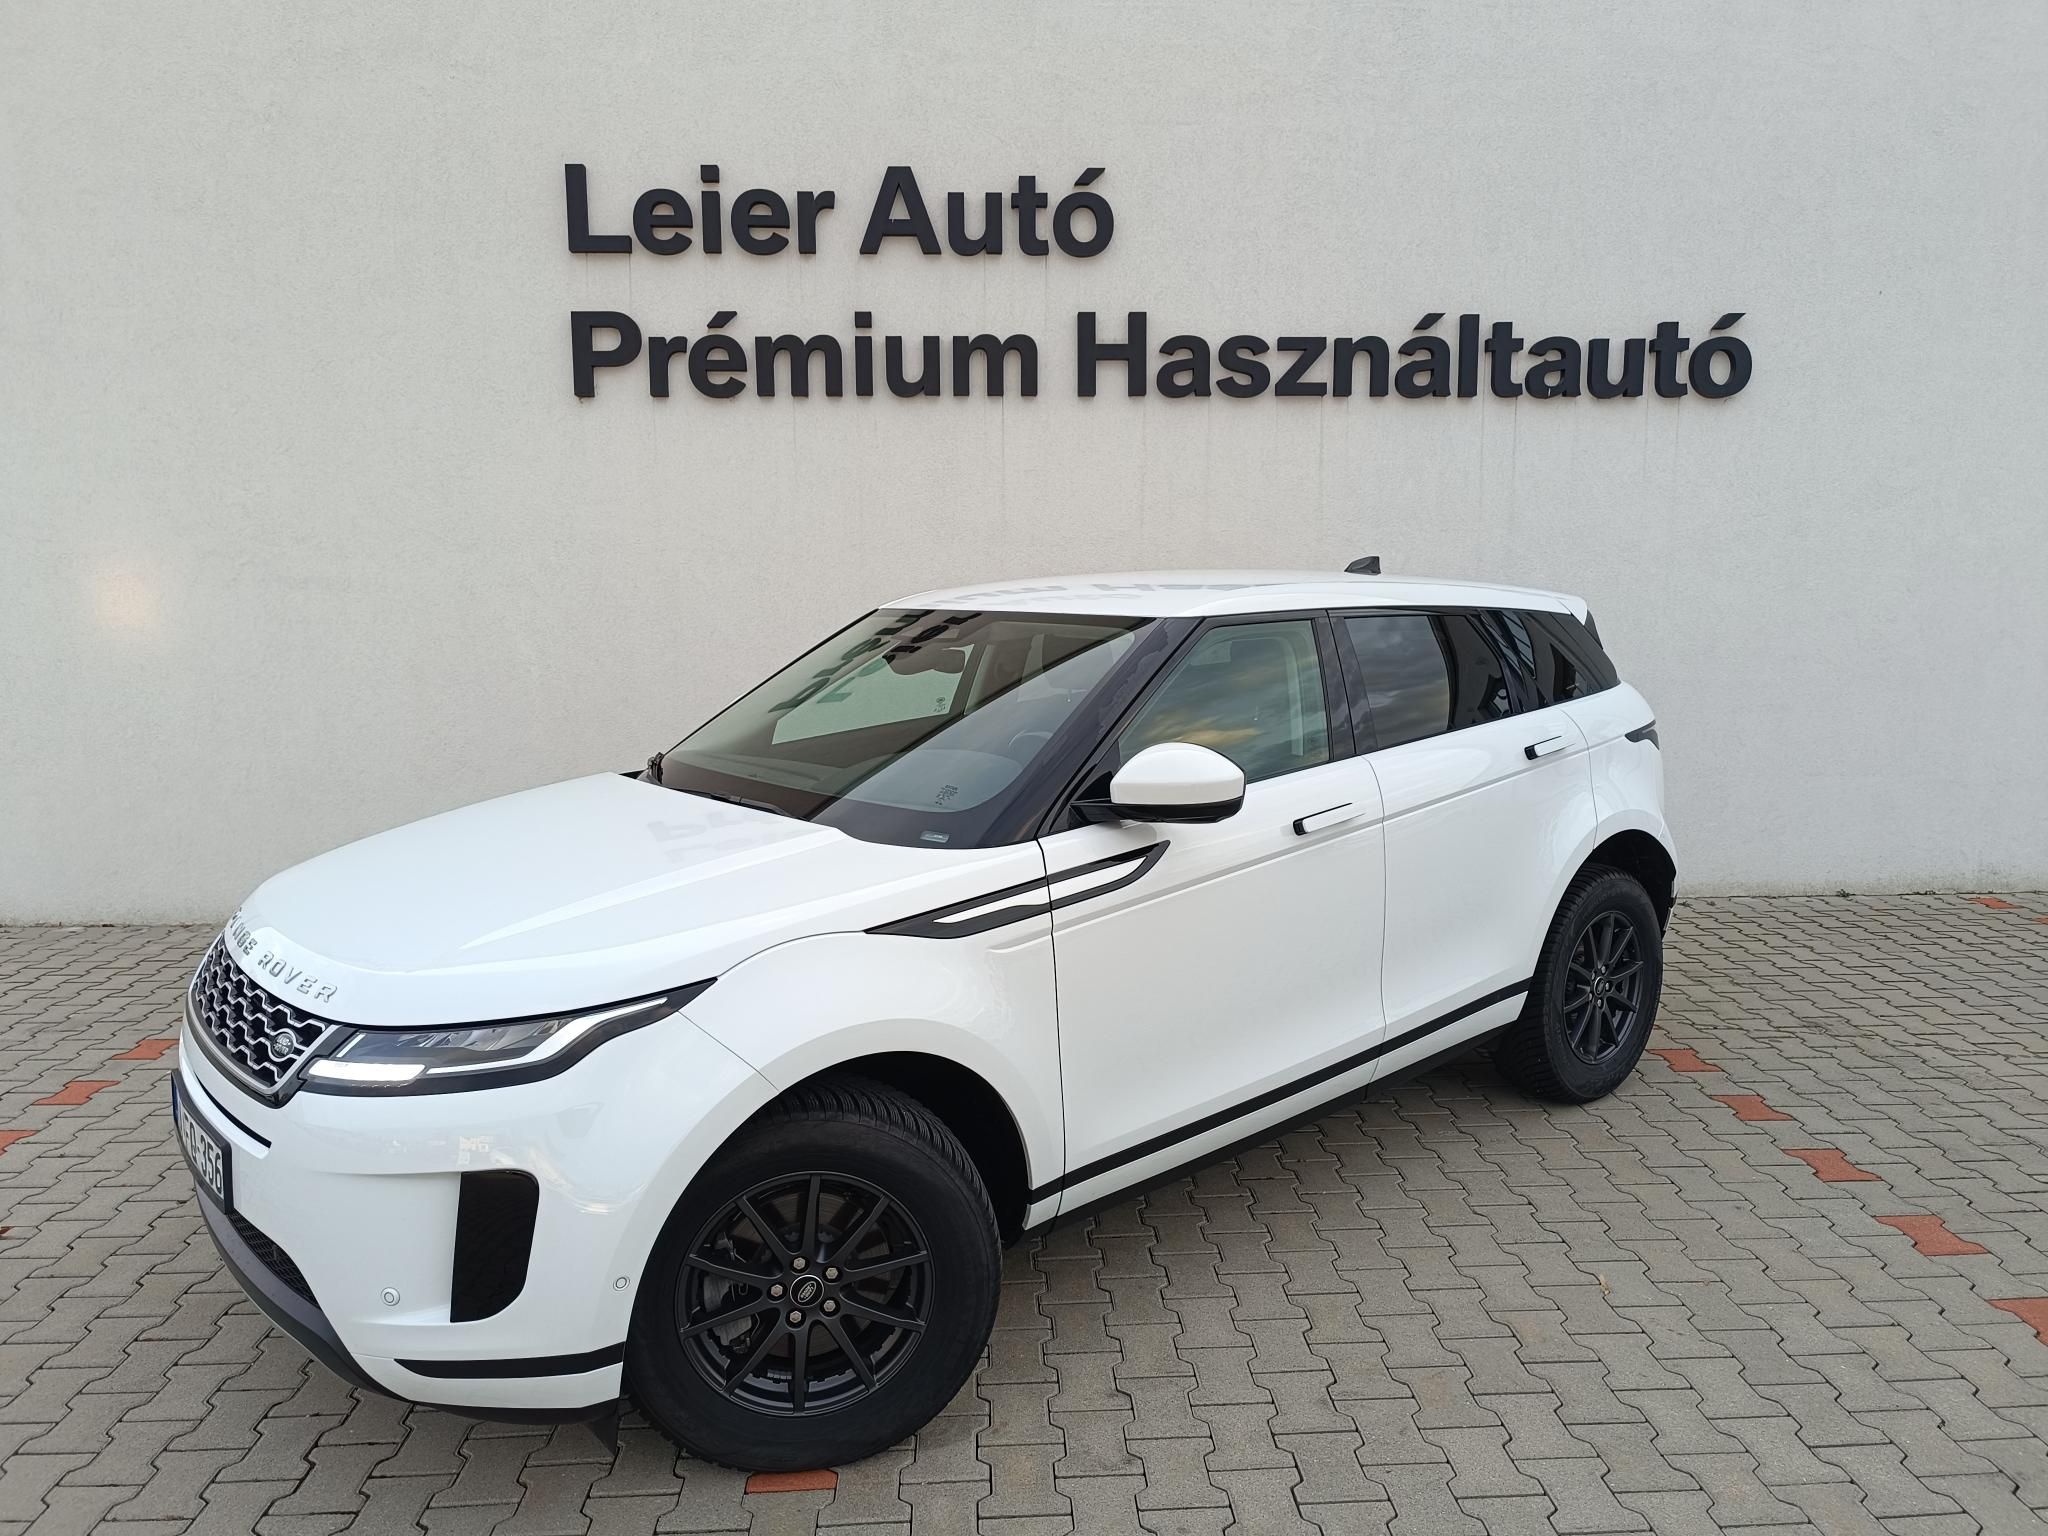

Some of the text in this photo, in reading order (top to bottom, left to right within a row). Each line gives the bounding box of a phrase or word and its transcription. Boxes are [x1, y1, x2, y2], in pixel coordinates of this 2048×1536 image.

[564, 163, 1115, 259] Leier Autó
[570, 310, 1753, 402] Prémium Használtautó
[257, 950, 338, 1003] ROVER
